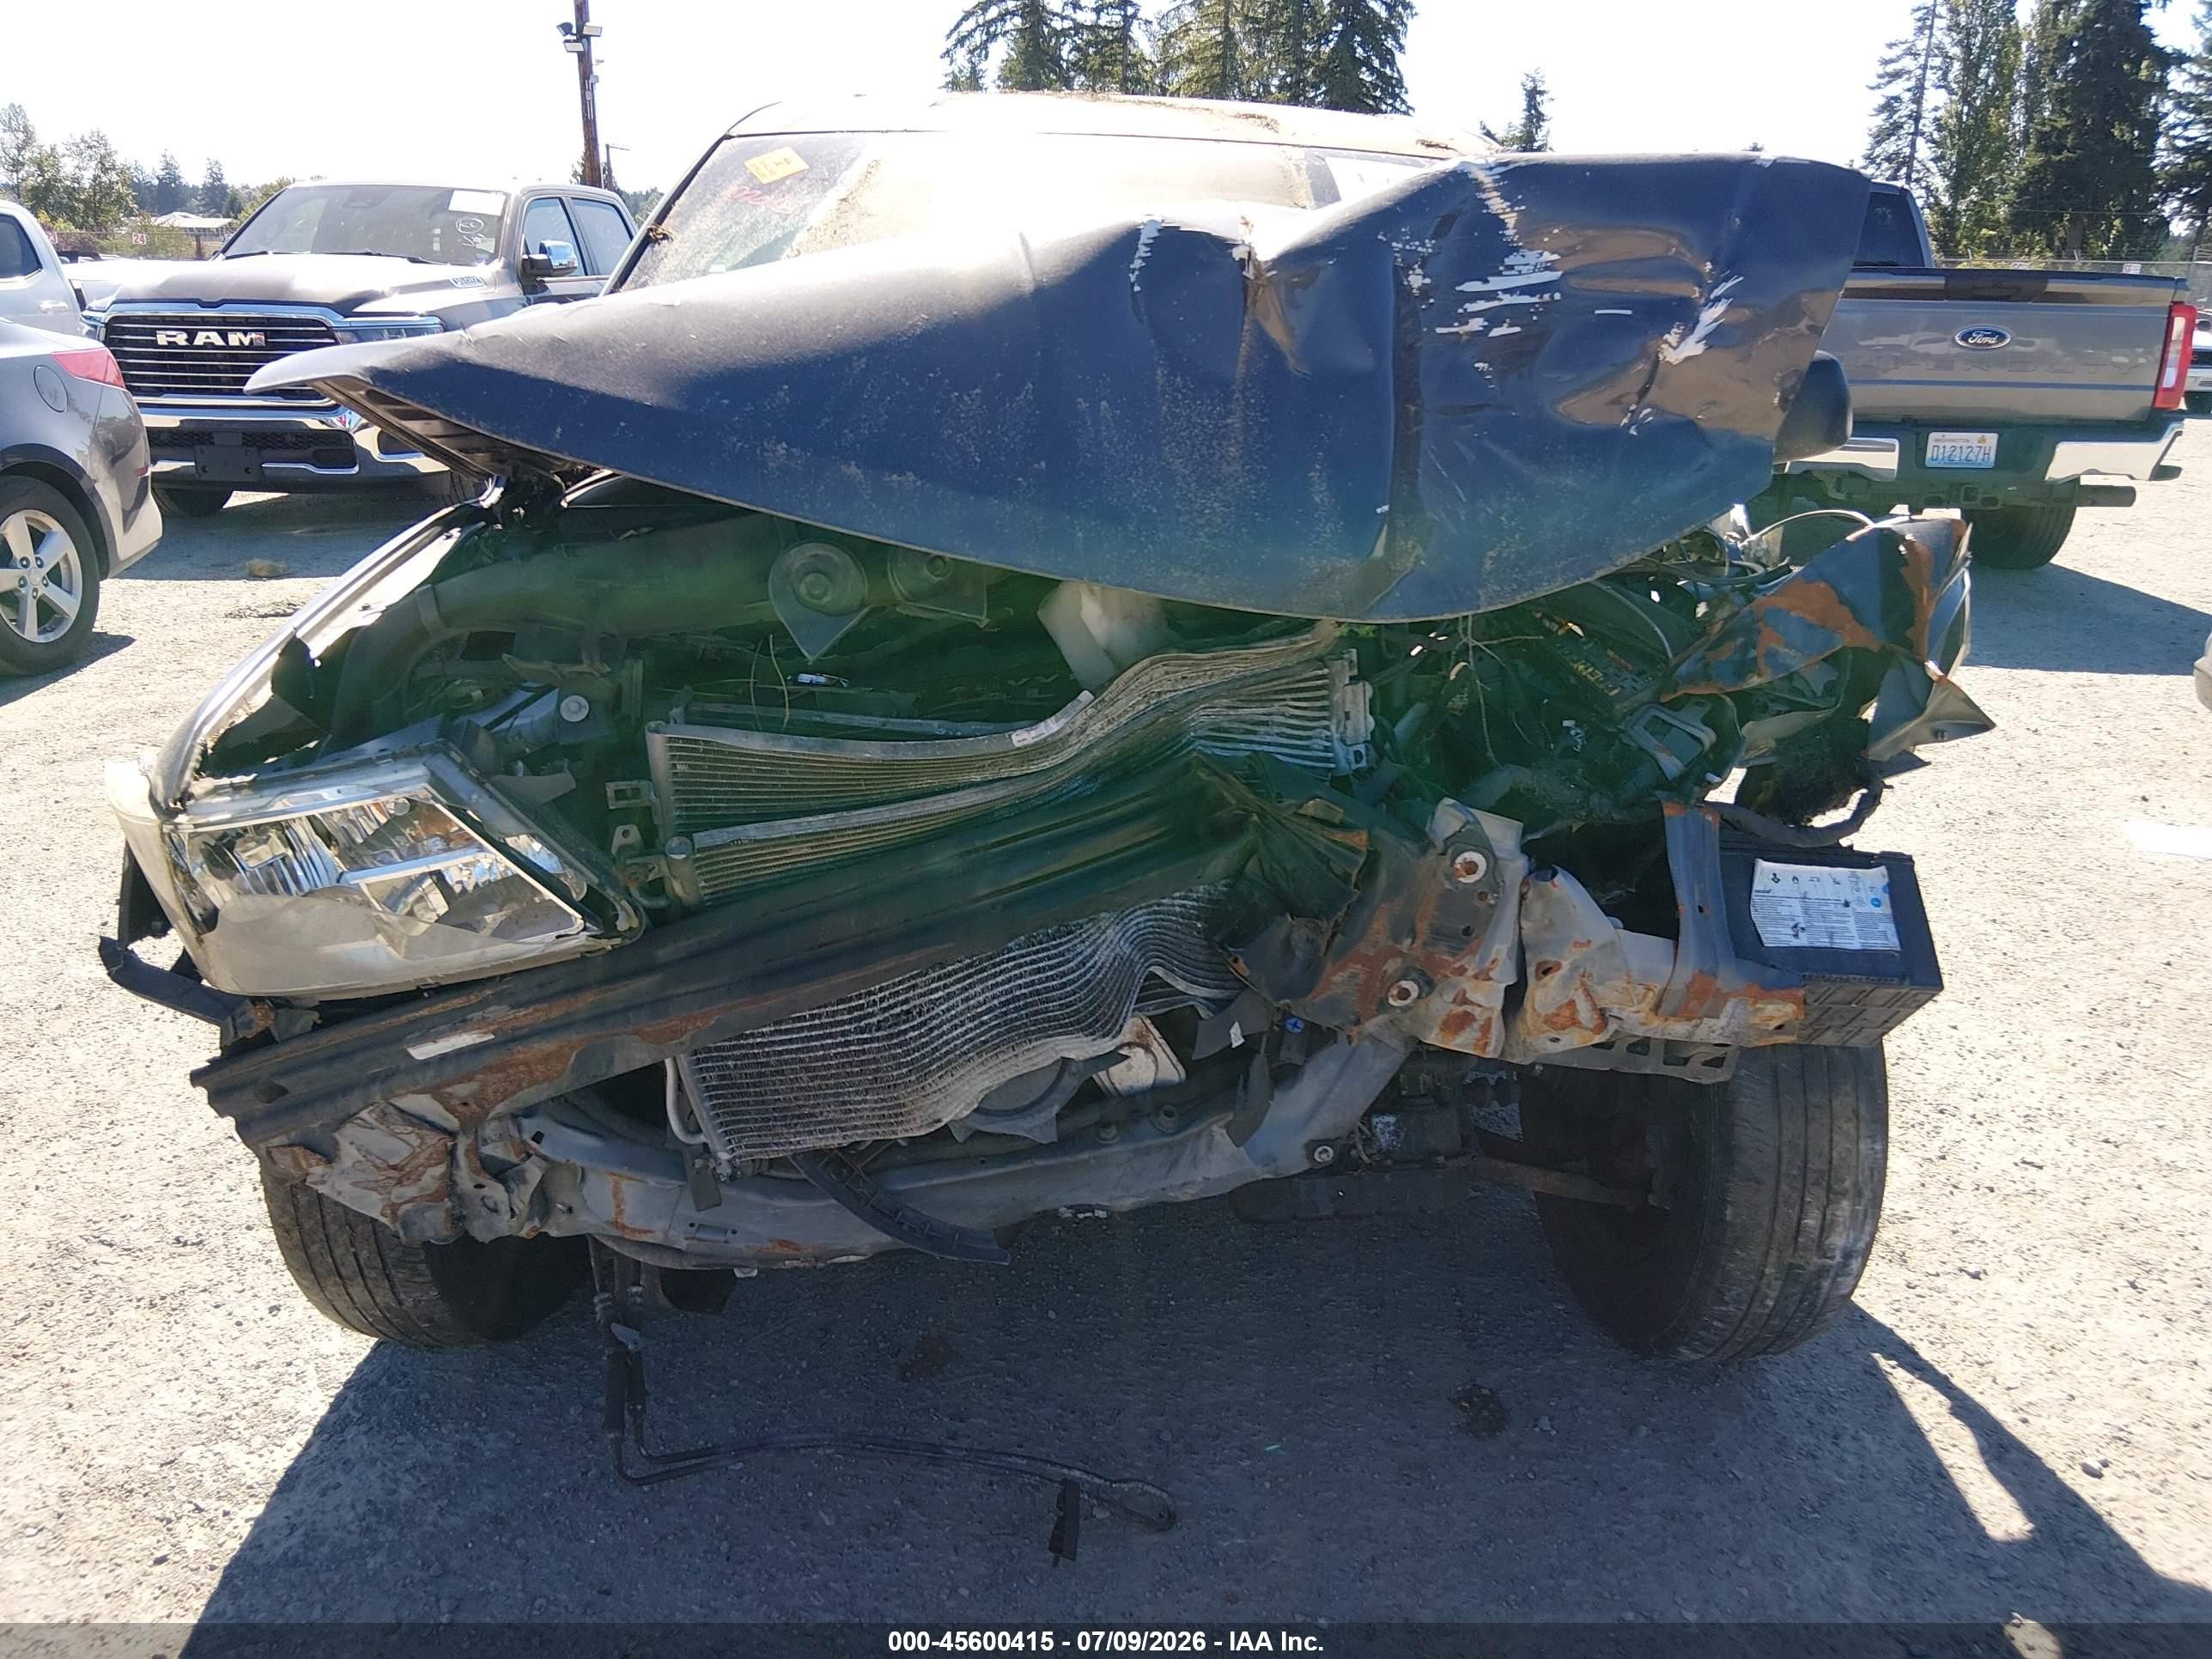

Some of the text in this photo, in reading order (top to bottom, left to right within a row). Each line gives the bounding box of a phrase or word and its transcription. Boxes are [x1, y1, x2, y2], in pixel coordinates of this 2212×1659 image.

[133, 234, 145, 245] 24
[155, 330, 265, 347] RAM
[1968, 331, 1999, 343] Ford
